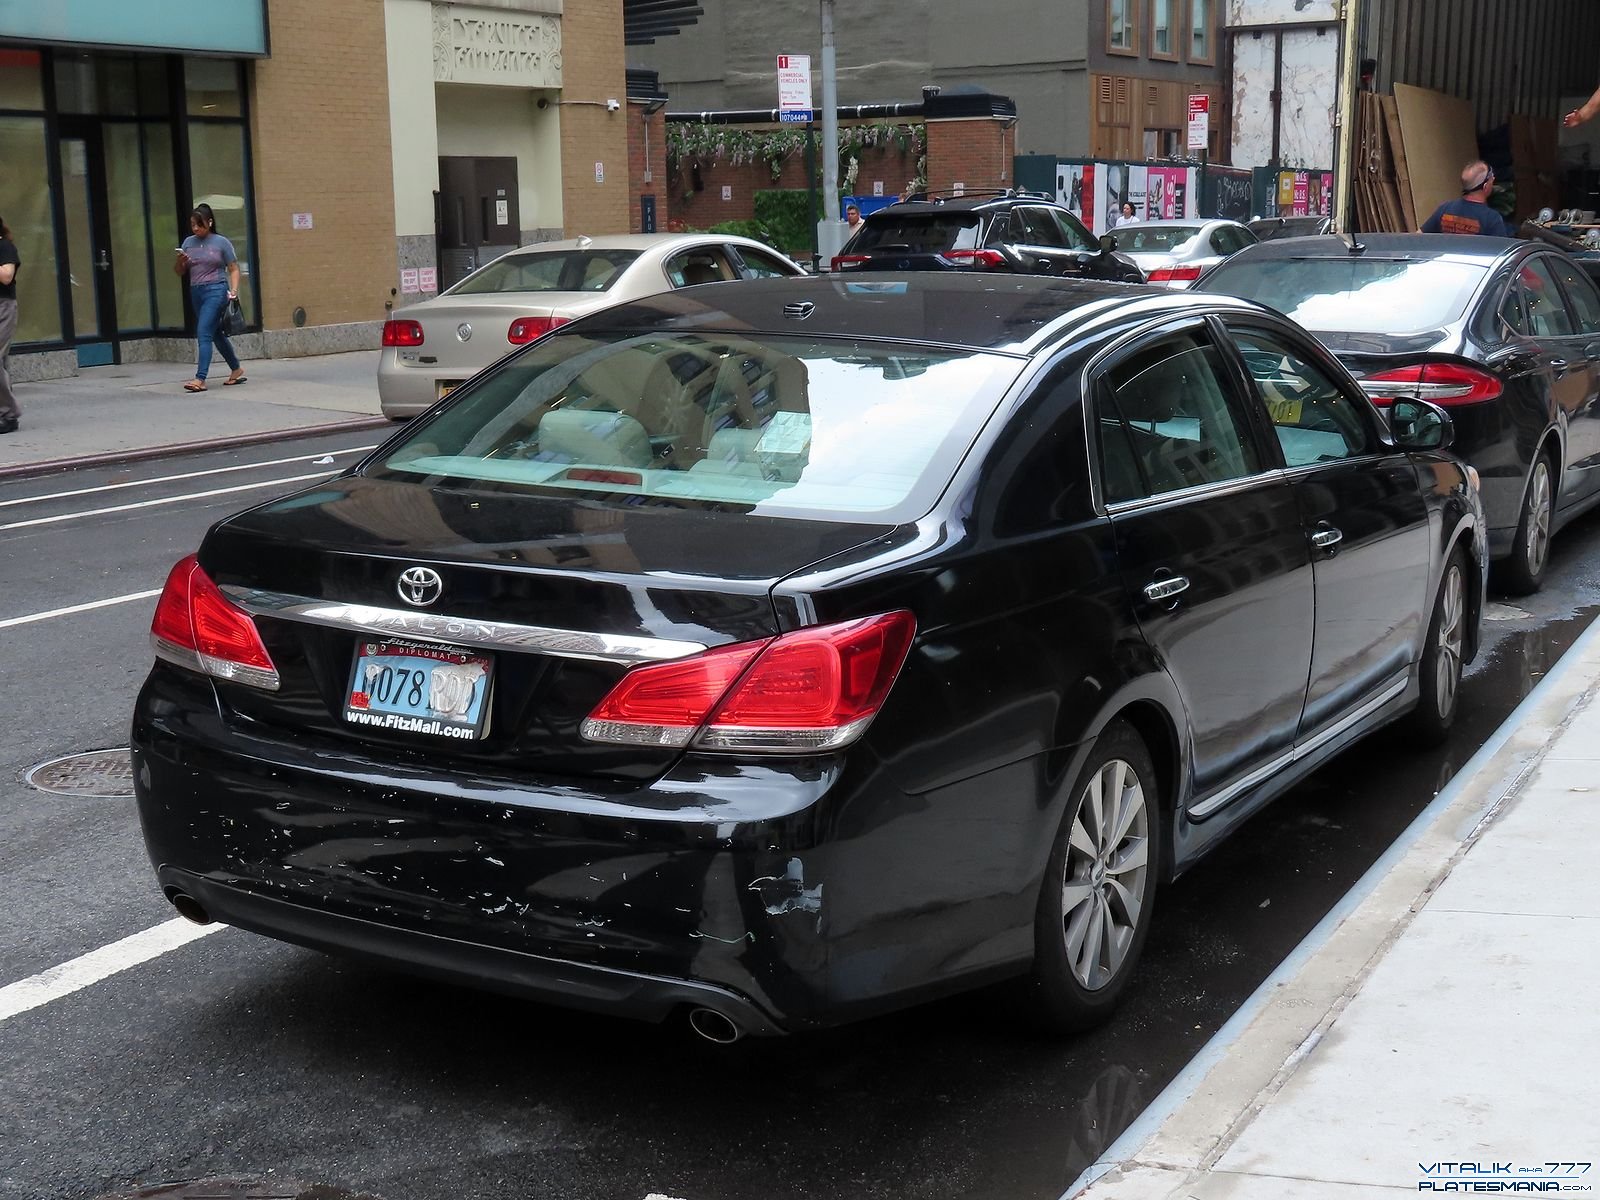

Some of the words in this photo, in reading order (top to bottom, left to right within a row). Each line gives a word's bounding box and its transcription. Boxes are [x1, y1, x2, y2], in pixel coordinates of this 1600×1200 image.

[341, 608, 496, 638] AVALON
[381, 638, 455, 652] Fitzgerald
[400, 648, 452, 660] DIPLOMAT
[346, 711, 474, 740] www.FitzMall.com
